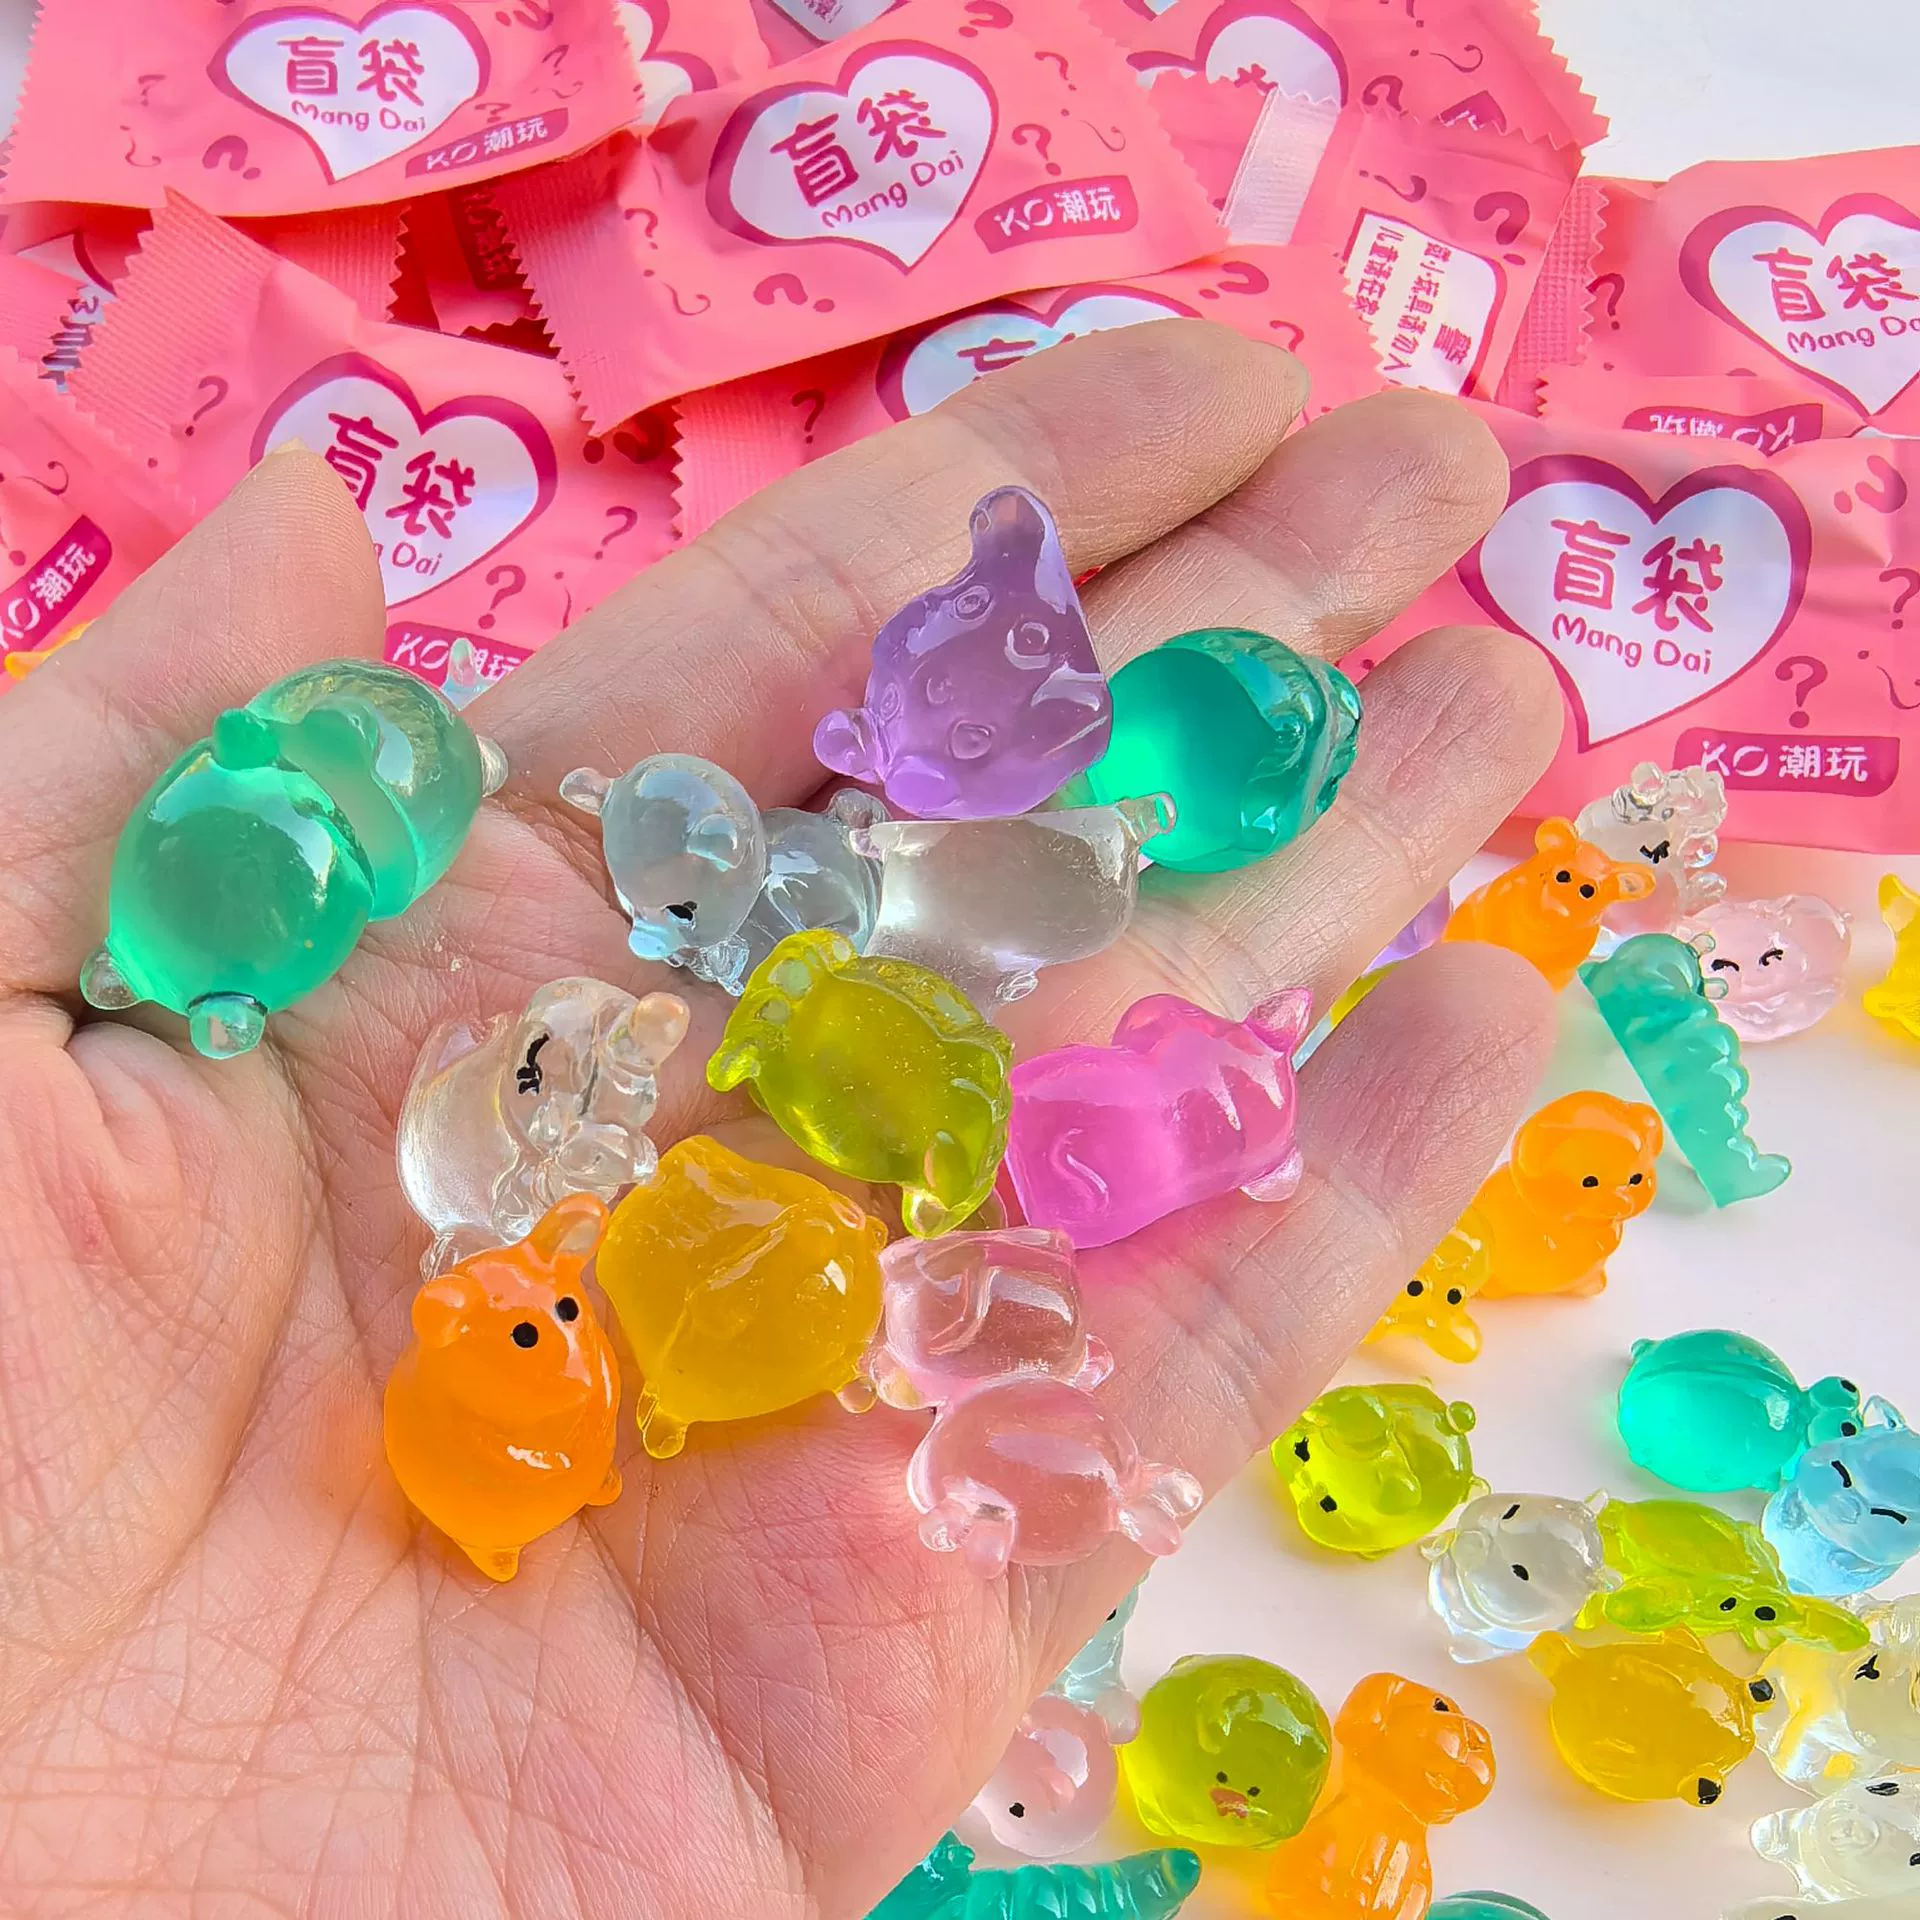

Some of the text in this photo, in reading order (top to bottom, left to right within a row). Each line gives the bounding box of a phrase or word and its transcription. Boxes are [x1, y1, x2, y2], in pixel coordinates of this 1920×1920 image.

[277, 36, 424, 106] 盲袋
[291, 100, 426, 133] Mang Dai
[484, 116, 548, 154] 潮玩
[769, 89, 947, 208] 盲袋
[822, 150, 965, 229] Mang Dai
[994, 186, 1122, 237] KO 潮玩
[1752, 247, 1920, 322] 盲袋
[1787, 328, 1875, 353] Mang
[29, 542, 96, 611] 潮玩
[391, 541, 443, 577] Dai
[1550, 519, 1723, 633] 盲袋
[392, 632, 448, 670] KO
[1552, 613, 1713, 675] Mang Dai
[1778, 745, 1869, 782] 潮玩
